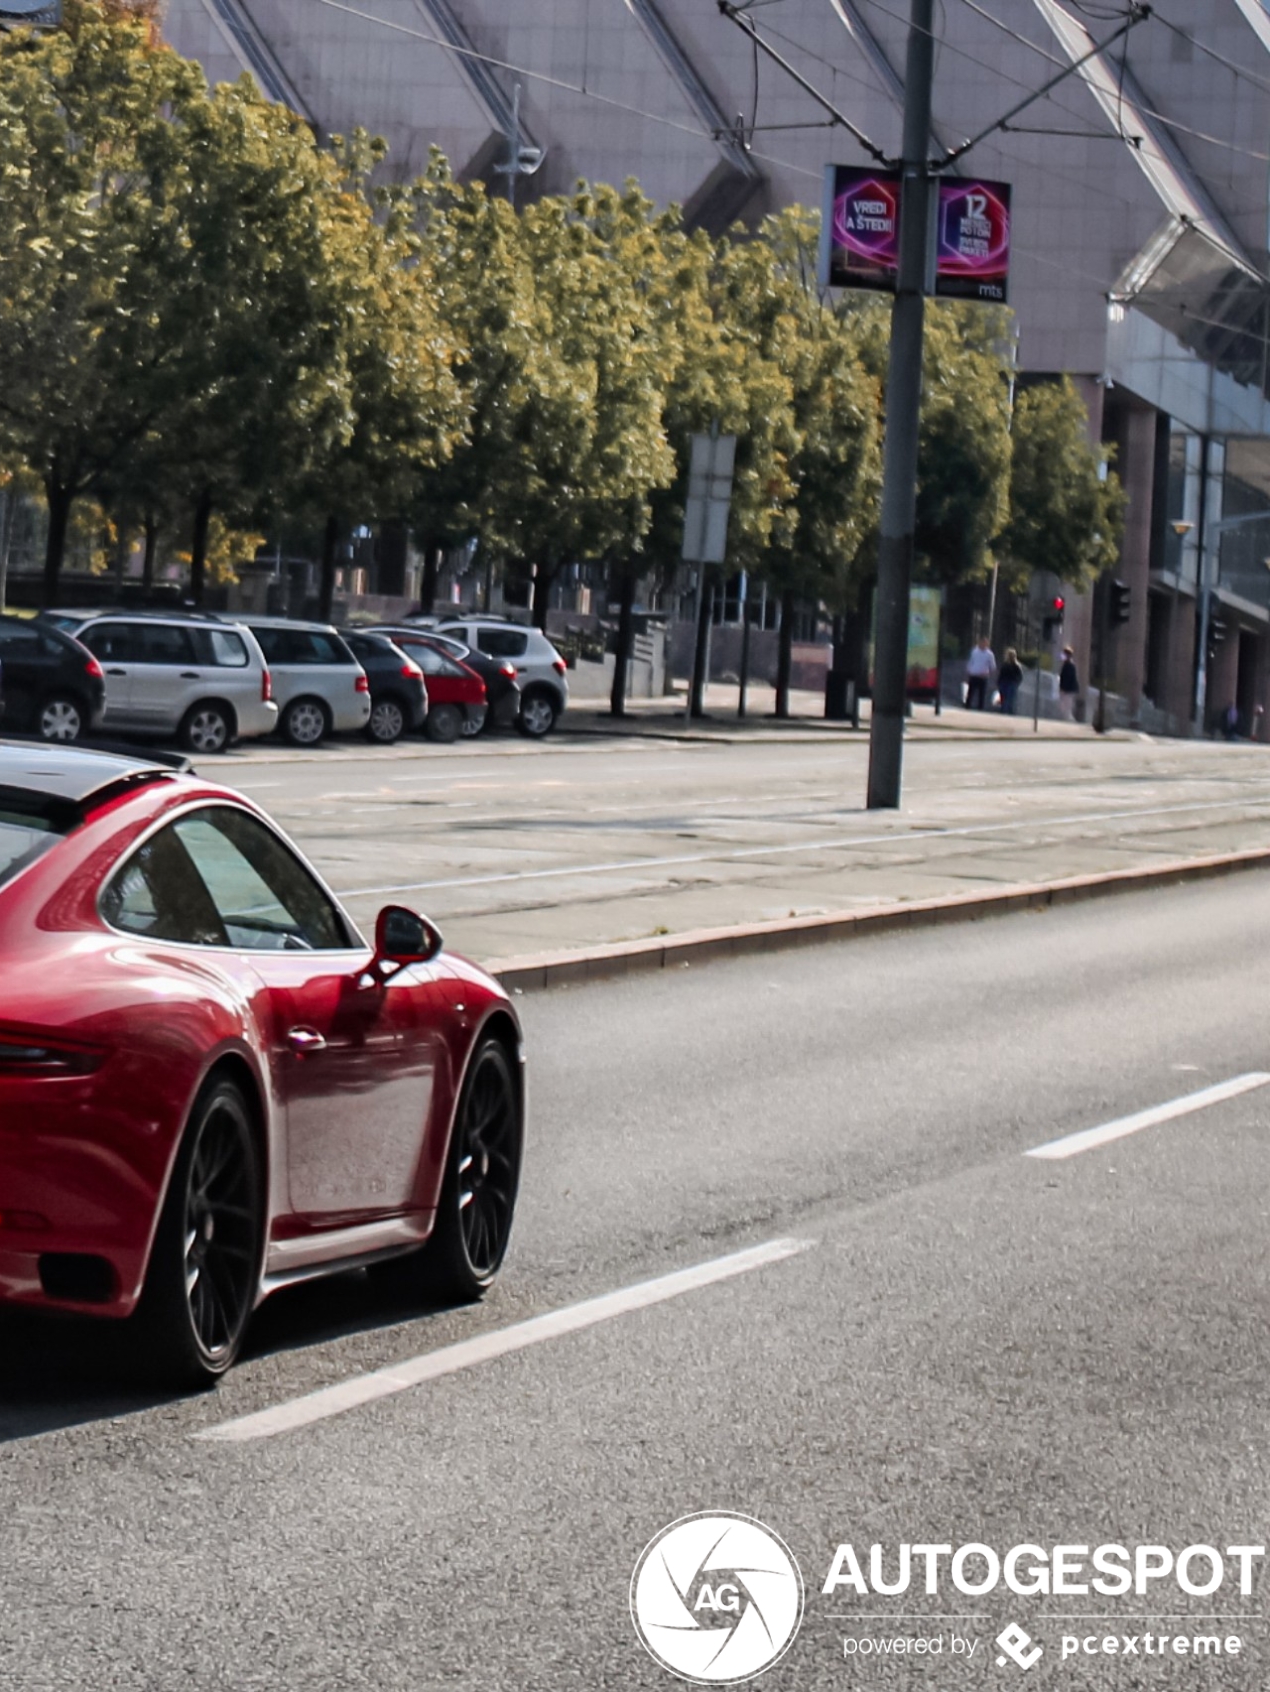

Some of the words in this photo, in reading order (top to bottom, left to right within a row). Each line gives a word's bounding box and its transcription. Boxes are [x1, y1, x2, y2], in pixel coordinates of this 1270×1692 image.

[853, 201, 887, 215] VREDI
[966, 194, 987, 219] 12
[846, 218, 855, 229] A
[979, 285, 1003, 298] mts
